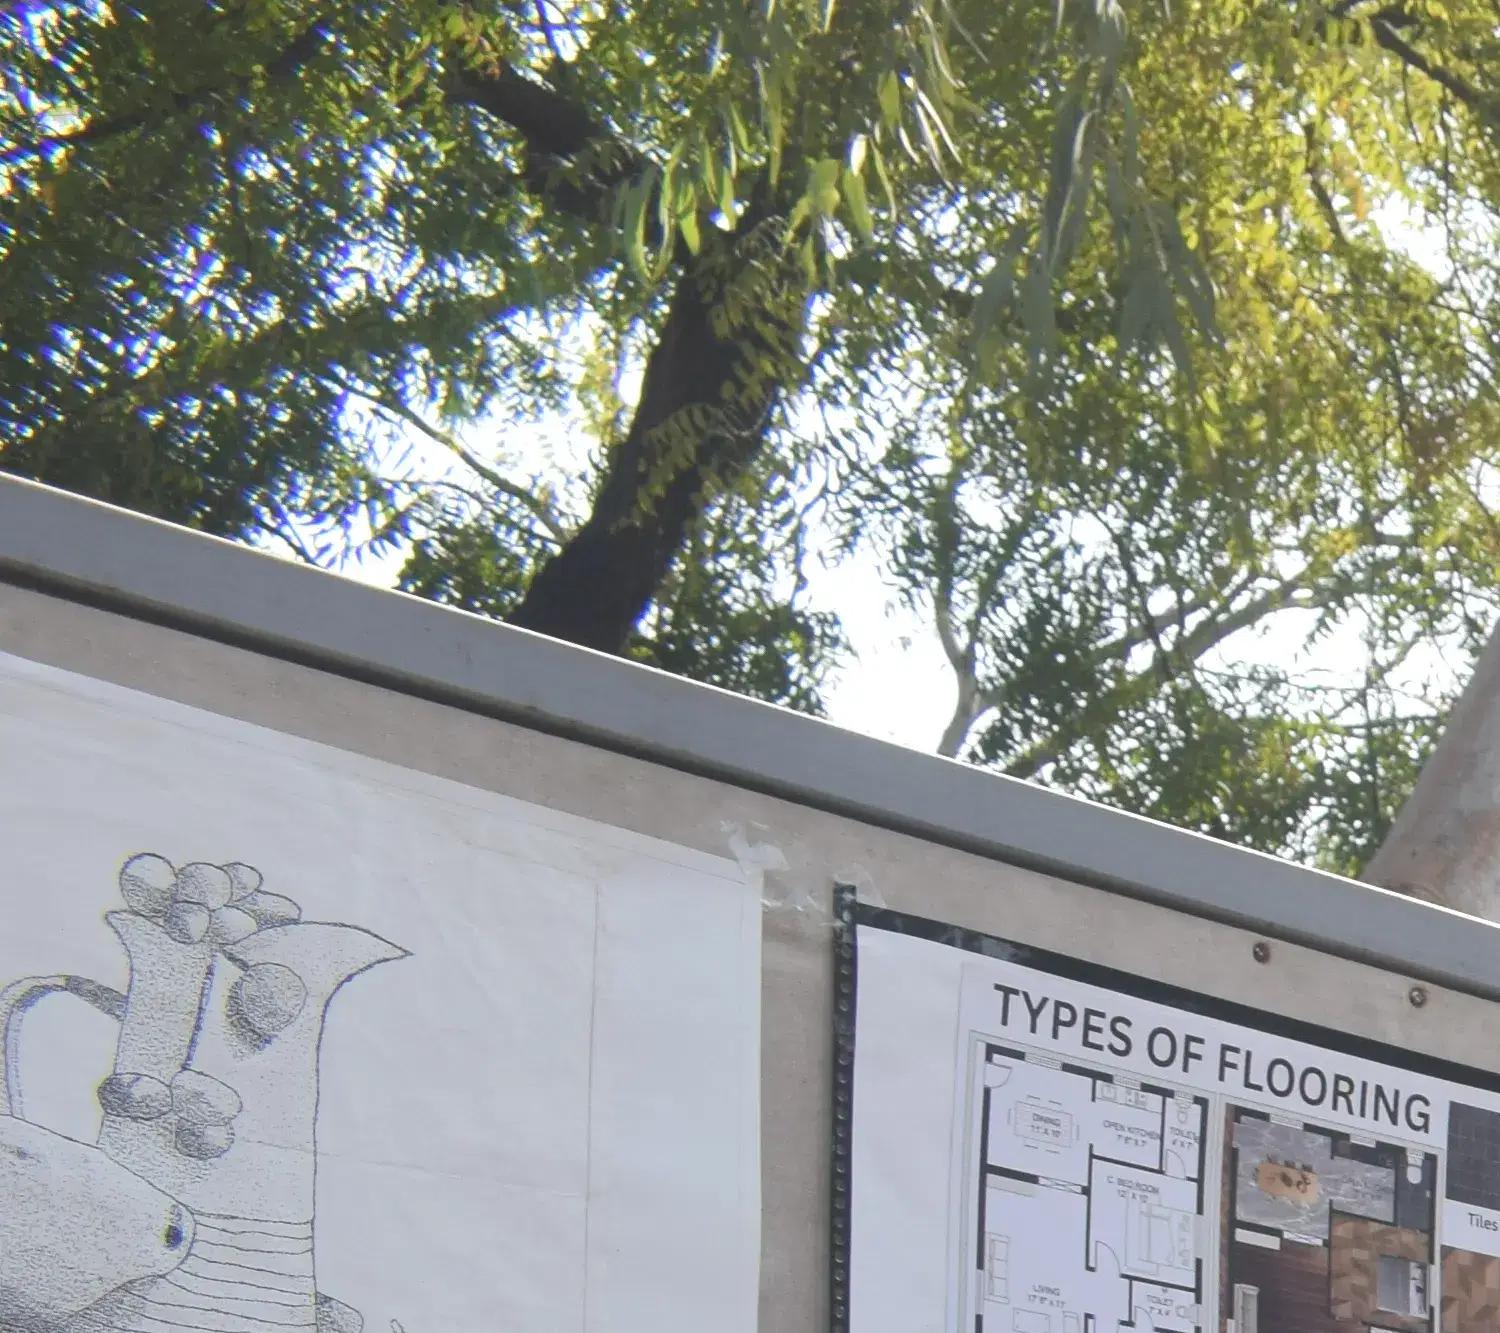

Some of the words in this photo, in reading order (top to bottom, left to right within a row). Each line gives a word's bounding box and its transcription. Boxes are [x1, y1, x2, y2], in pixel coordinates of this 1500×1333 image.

[994, 983, 1133, 1057] TYPES
[1147, 1026, 1205, 1073] OF
[1218, 1043, 1430, 1134] FLOORING
[1103, 1119, 1126, 1132] OPEN
[1128, 1124, 1161, 1140] KITCHEN
[1468, 1213, 1499, 1231] Tiles
[1033, 1285, 1060, 1296] LIVING
